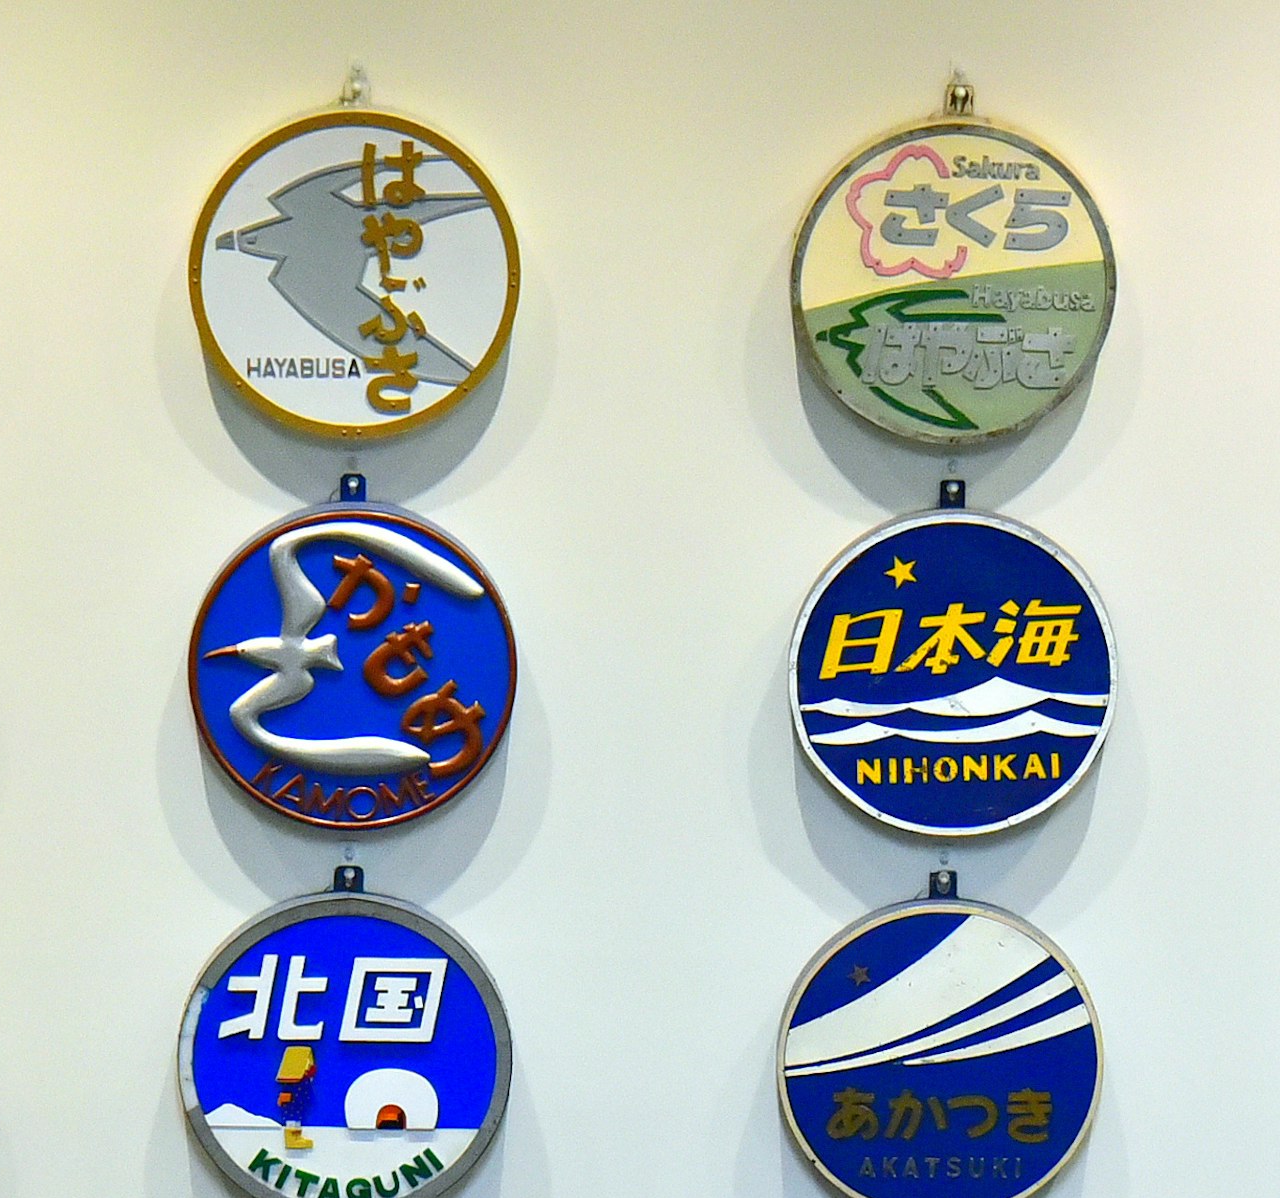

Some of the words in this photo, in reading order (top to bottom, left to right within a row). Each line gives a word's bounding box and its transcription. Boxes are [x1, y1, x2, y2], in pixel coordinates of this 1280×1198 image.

[951, 155, 1040, 181] Sakura
[880, 184, 1072, 252] さくら
[358, 141, 427, 413] はやぶさ
[971, 284, 1096, 312] Hayabusa
[246, 357, 361, 379] HAYABUSA
[861, 323, 1075, 390] はやぶさ
[327, 554, 486, 778] かもめ
[819, 600, 1082, 679] 日本海
[250, 761, 435, 820] KAMOME
[857, 752, 1062, 785] NIHONKAI
[218, 954, 449, 1043] 北国
[826, 1087, 1053, 1144] あかつき
[858, 1156, 1021, 1179] AKATSUKI
